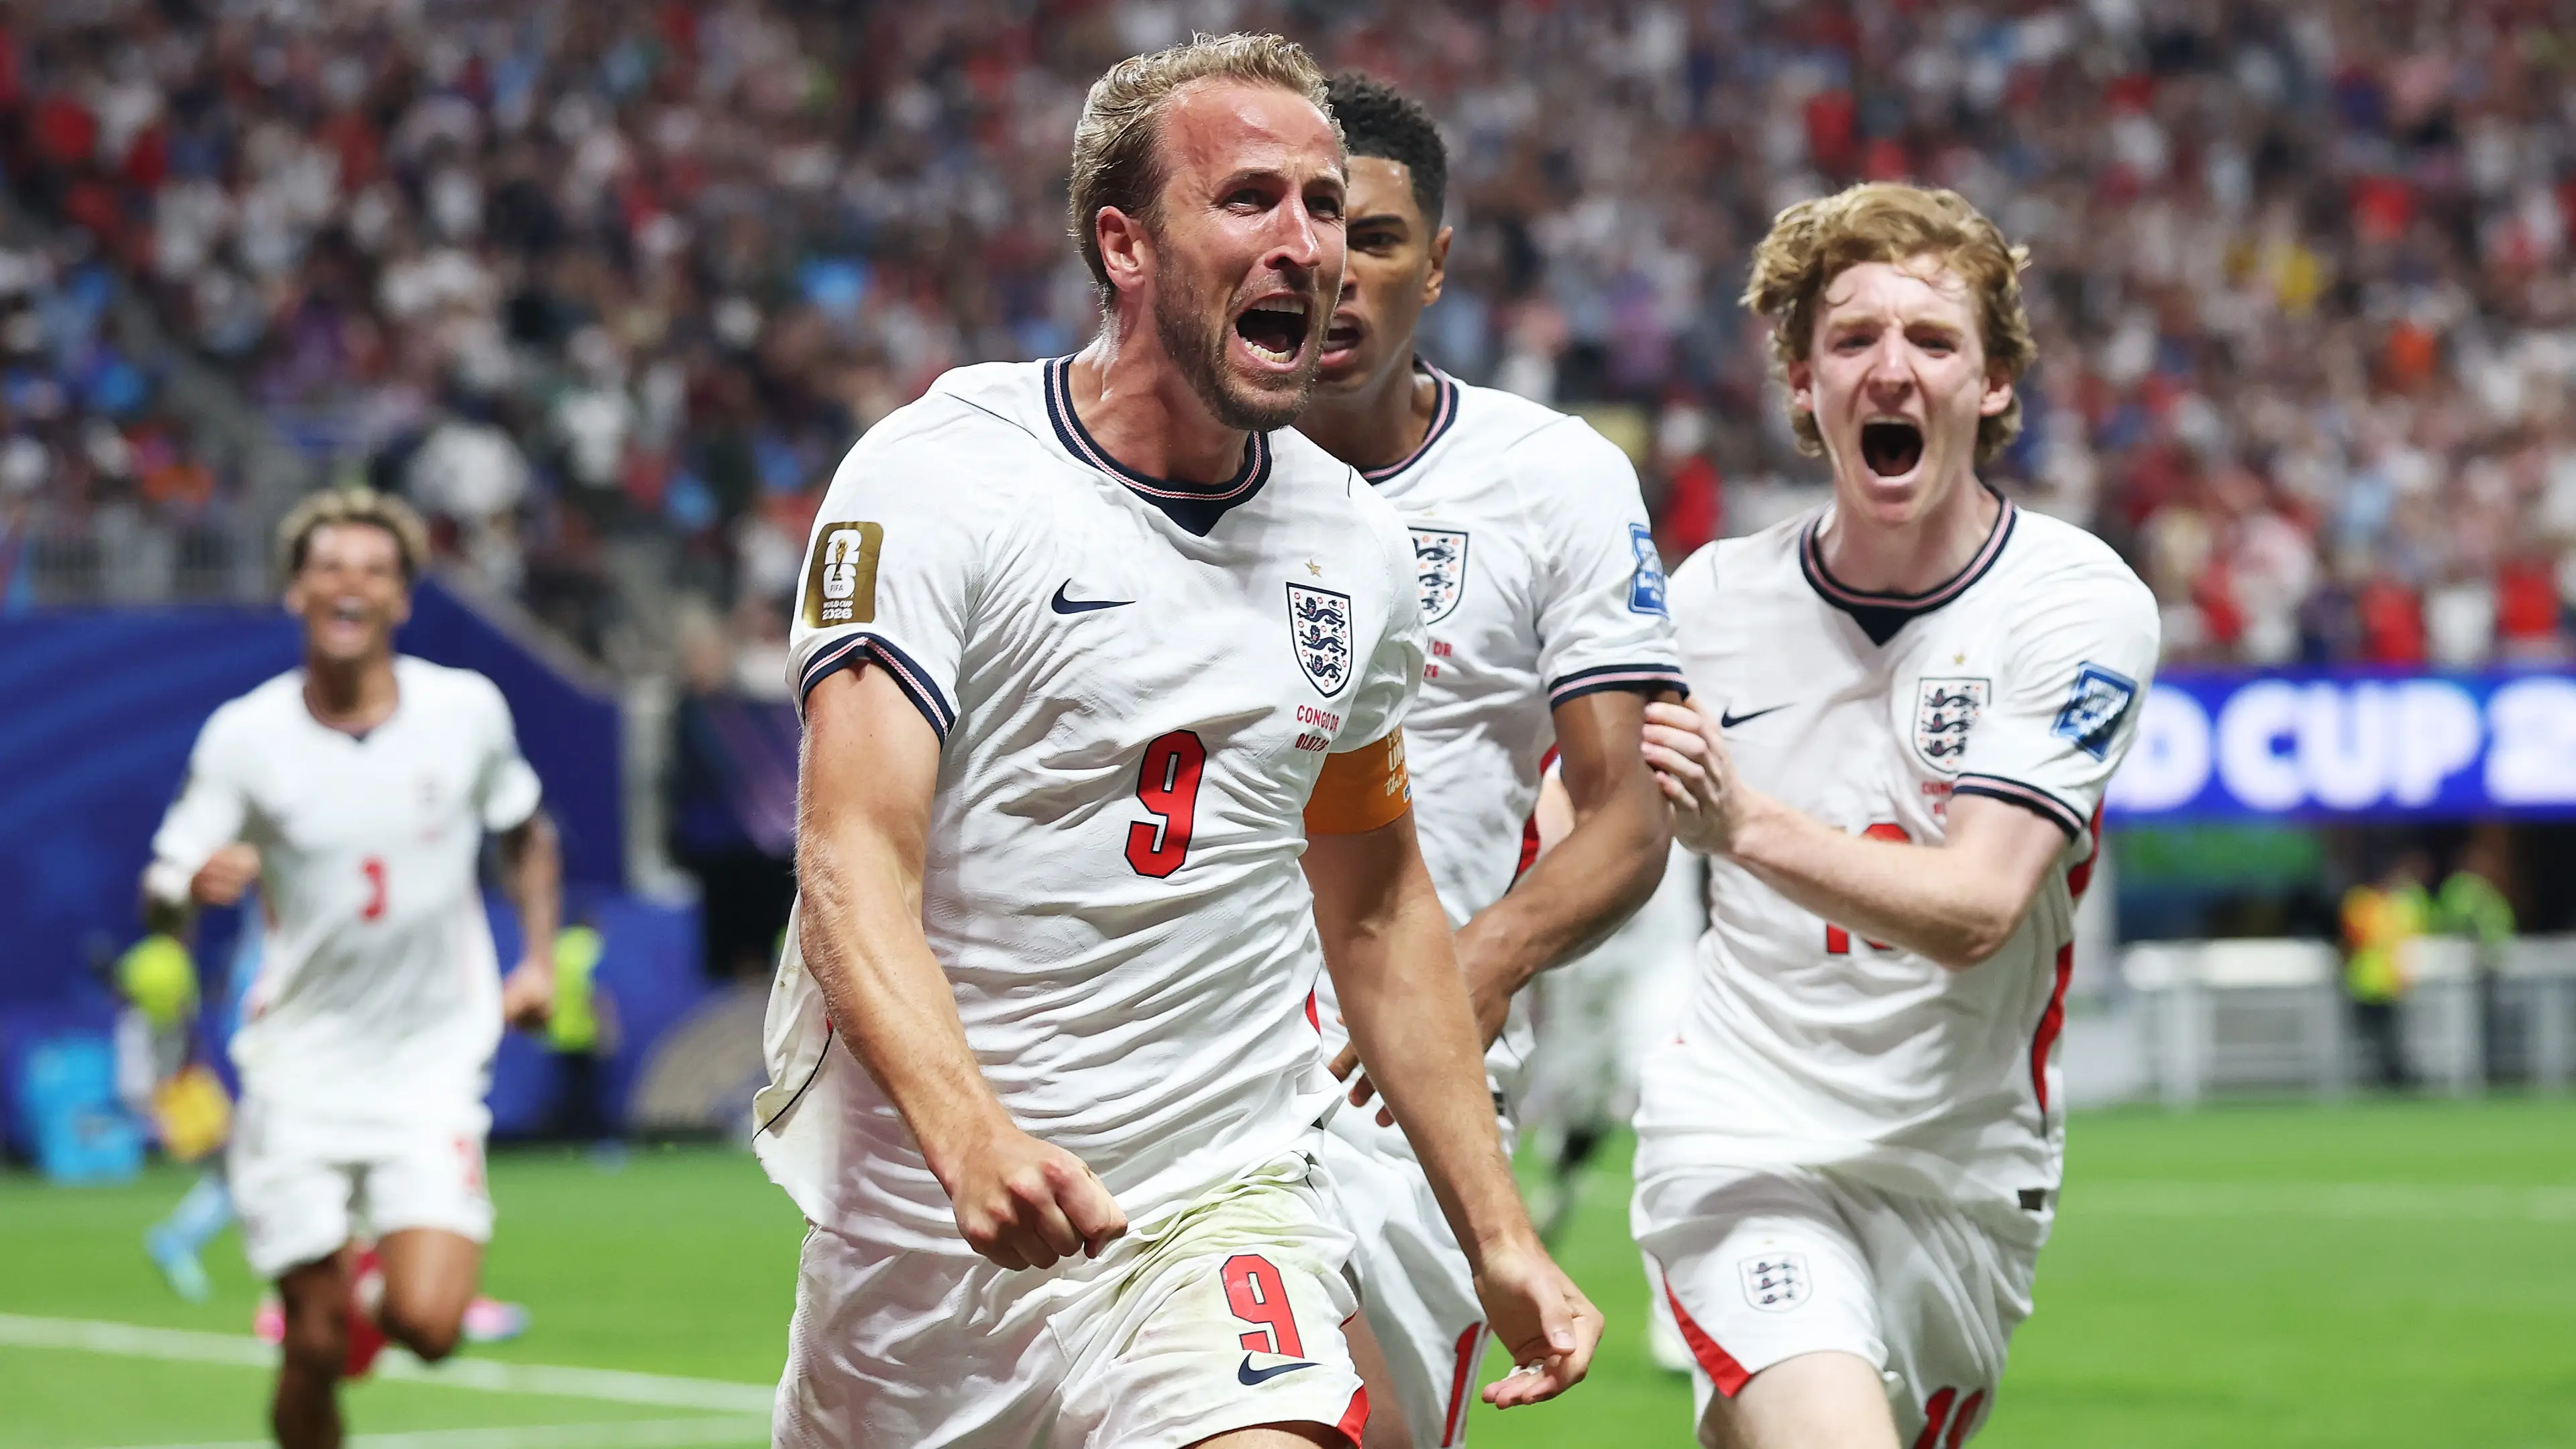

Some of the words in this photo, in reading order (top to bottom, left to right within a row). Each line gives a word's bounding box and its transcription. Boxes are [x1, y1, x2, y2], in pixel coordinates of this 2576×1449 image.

[822, 607, 853, 621] 2026
[830, 584, 843, 593] FIFA
[1297, 704, 1331, 729] CONGO
[2216, 678, 2482, 811] CUP
[1124, 729, 1207, 879] 9
[1220, 1253, 1305, 1360] 9
